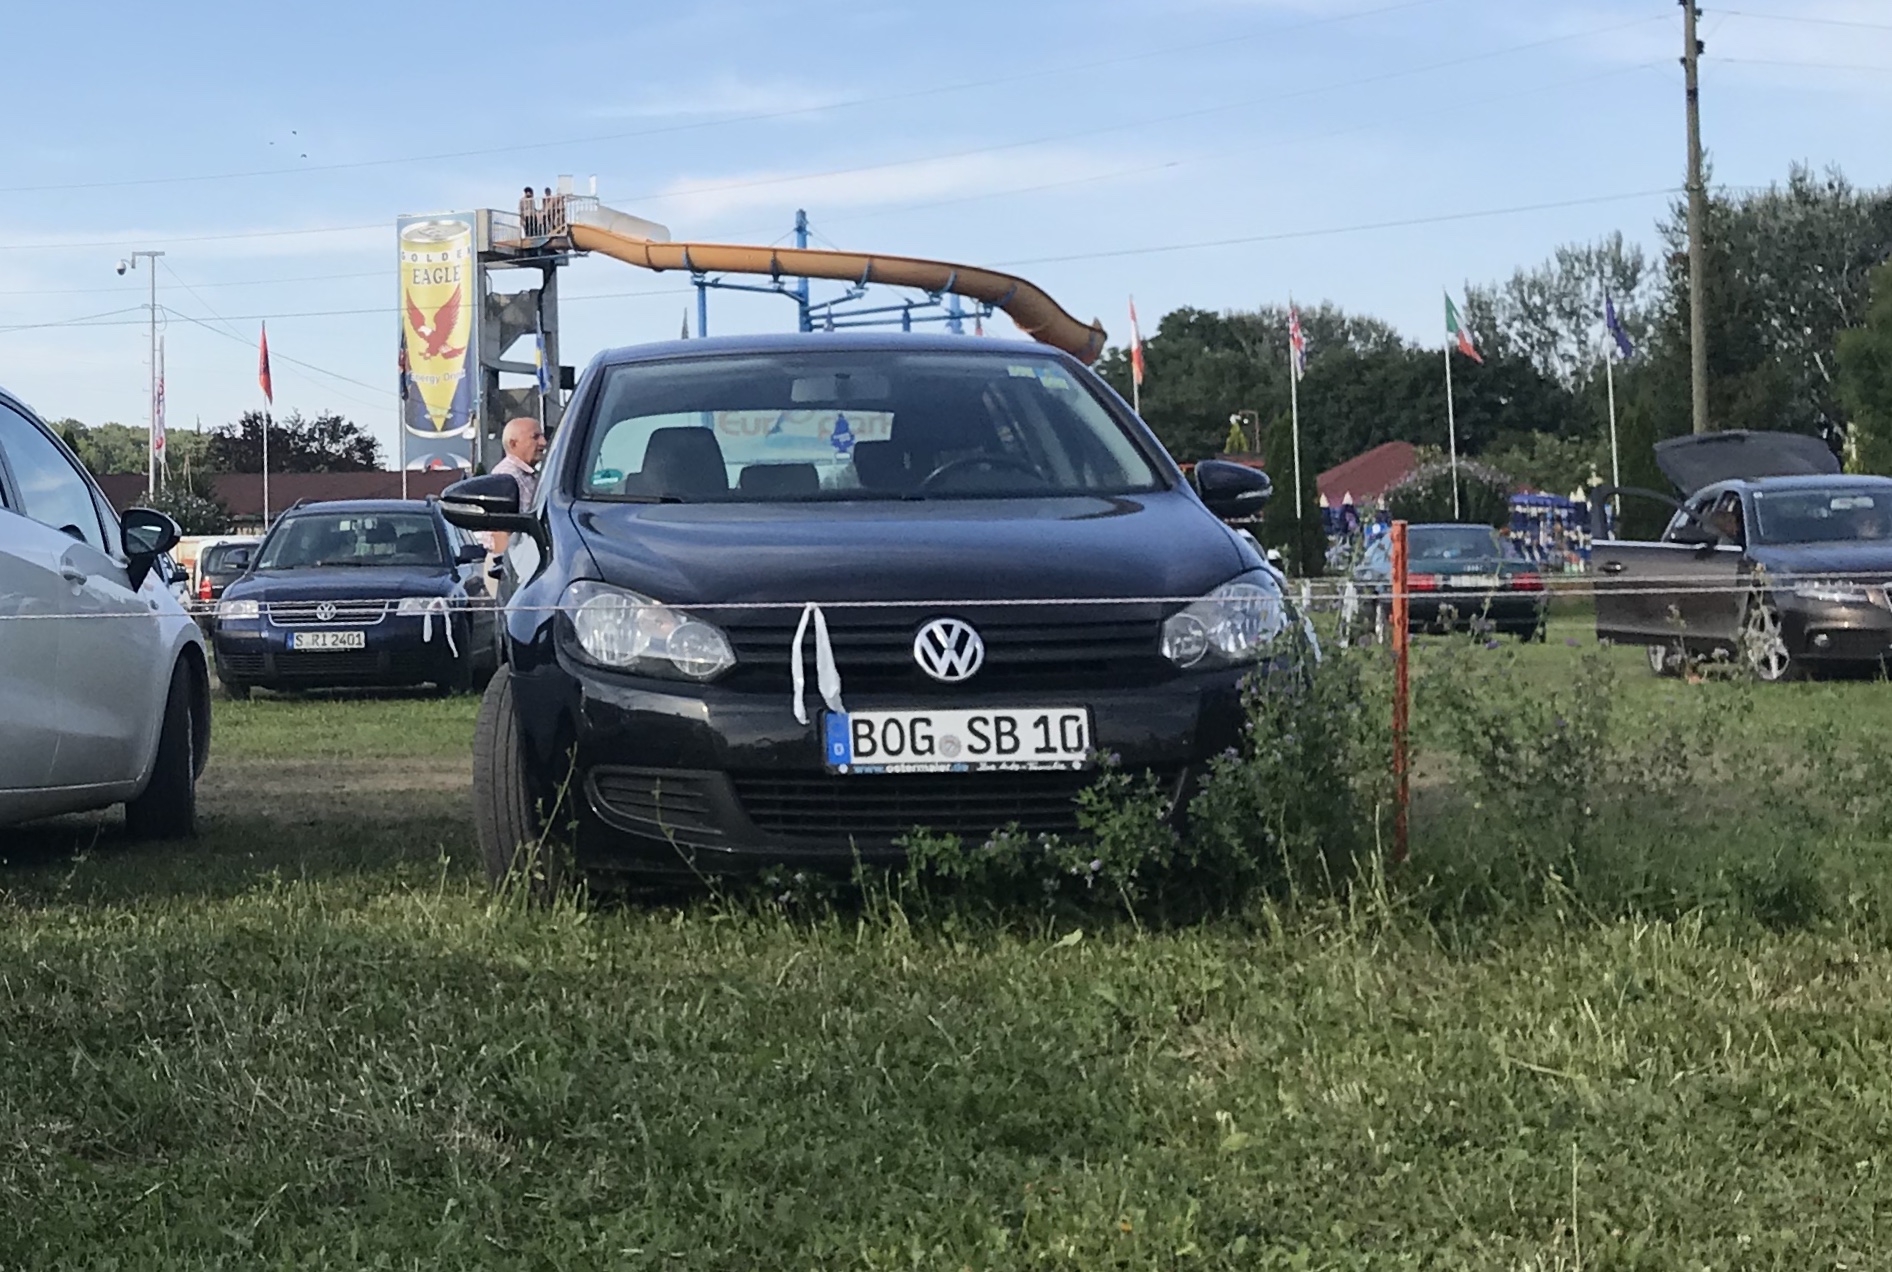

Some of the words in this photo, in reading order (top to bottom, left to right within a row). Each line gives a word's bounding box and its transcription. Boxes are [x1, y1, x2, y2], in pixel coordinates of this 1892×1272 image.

[412, 265, 461, 285] EAGLE
[295, 634, 304, 647] S
[311, 634, 327, 646] RI
[331, 633, 363, 646] 2401
[914, 618, 984, 680] VW
[852, 717, 935, 758] BOG
[967, 715, 1020, 755] SB
[1033, 714, 1084, 754] 10
